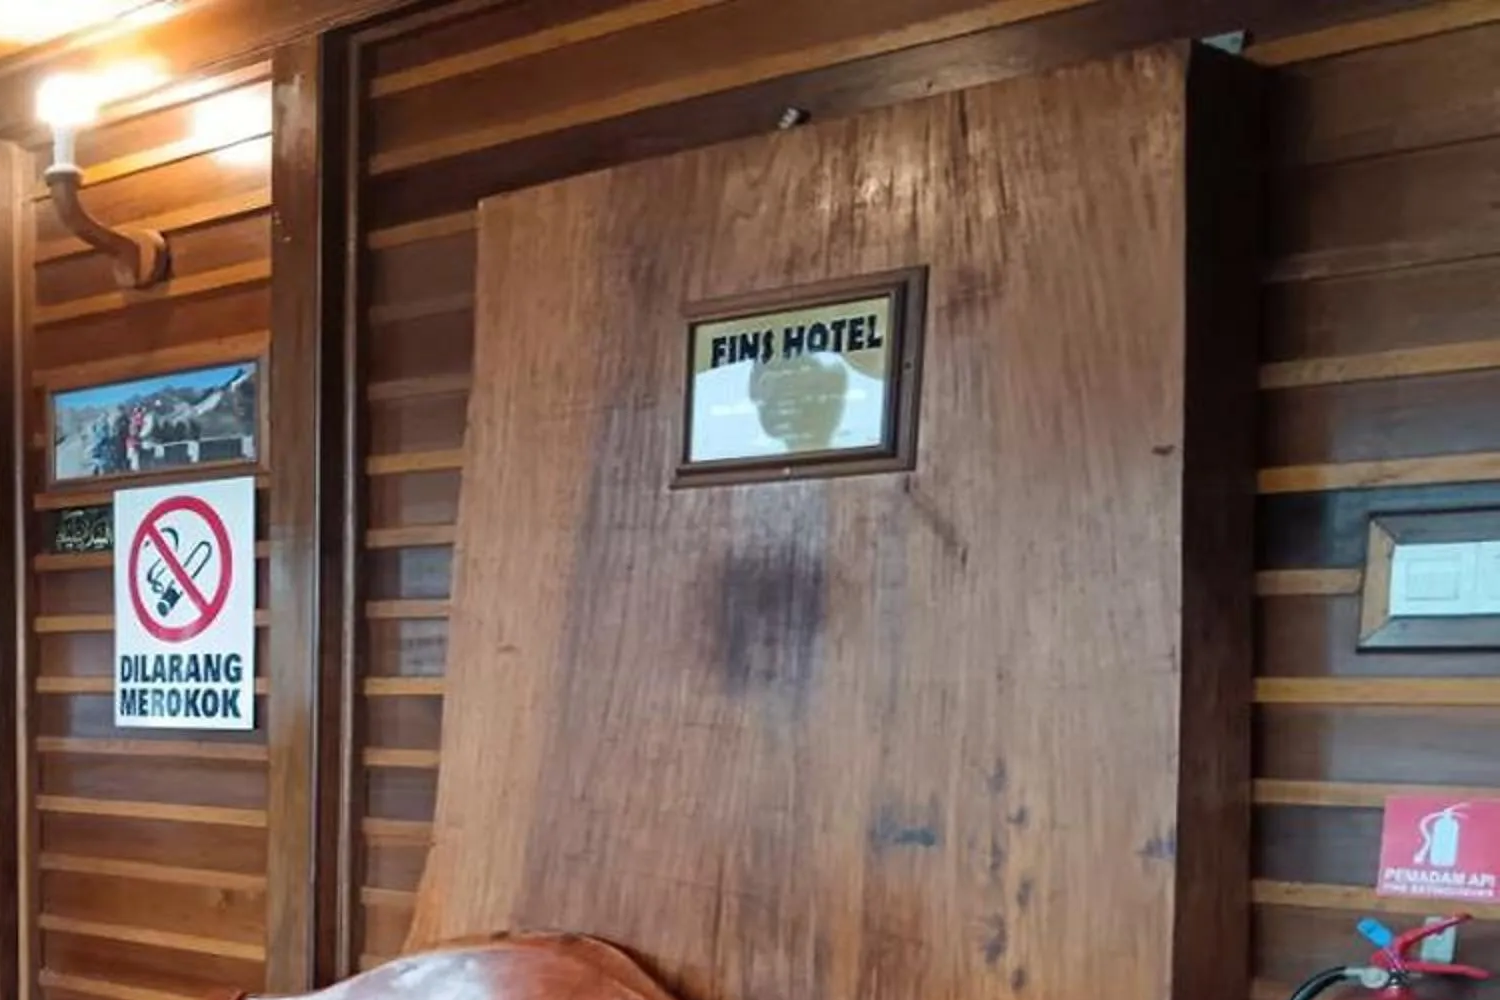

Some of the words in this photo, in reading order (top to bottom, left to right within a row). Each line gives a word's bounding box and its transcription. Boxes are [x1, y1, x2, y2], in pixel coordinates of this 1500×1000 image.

[710, 329, 775, 369] FINS
[783, 314, 884, 359] HOTEL
[120, 652, 242, 684] DILARANG
[120, 687, 242, 719] MEROKOK
[1384, 867, 1465, 887] PEMADAM
[1467, 872, 1495, 889] API
